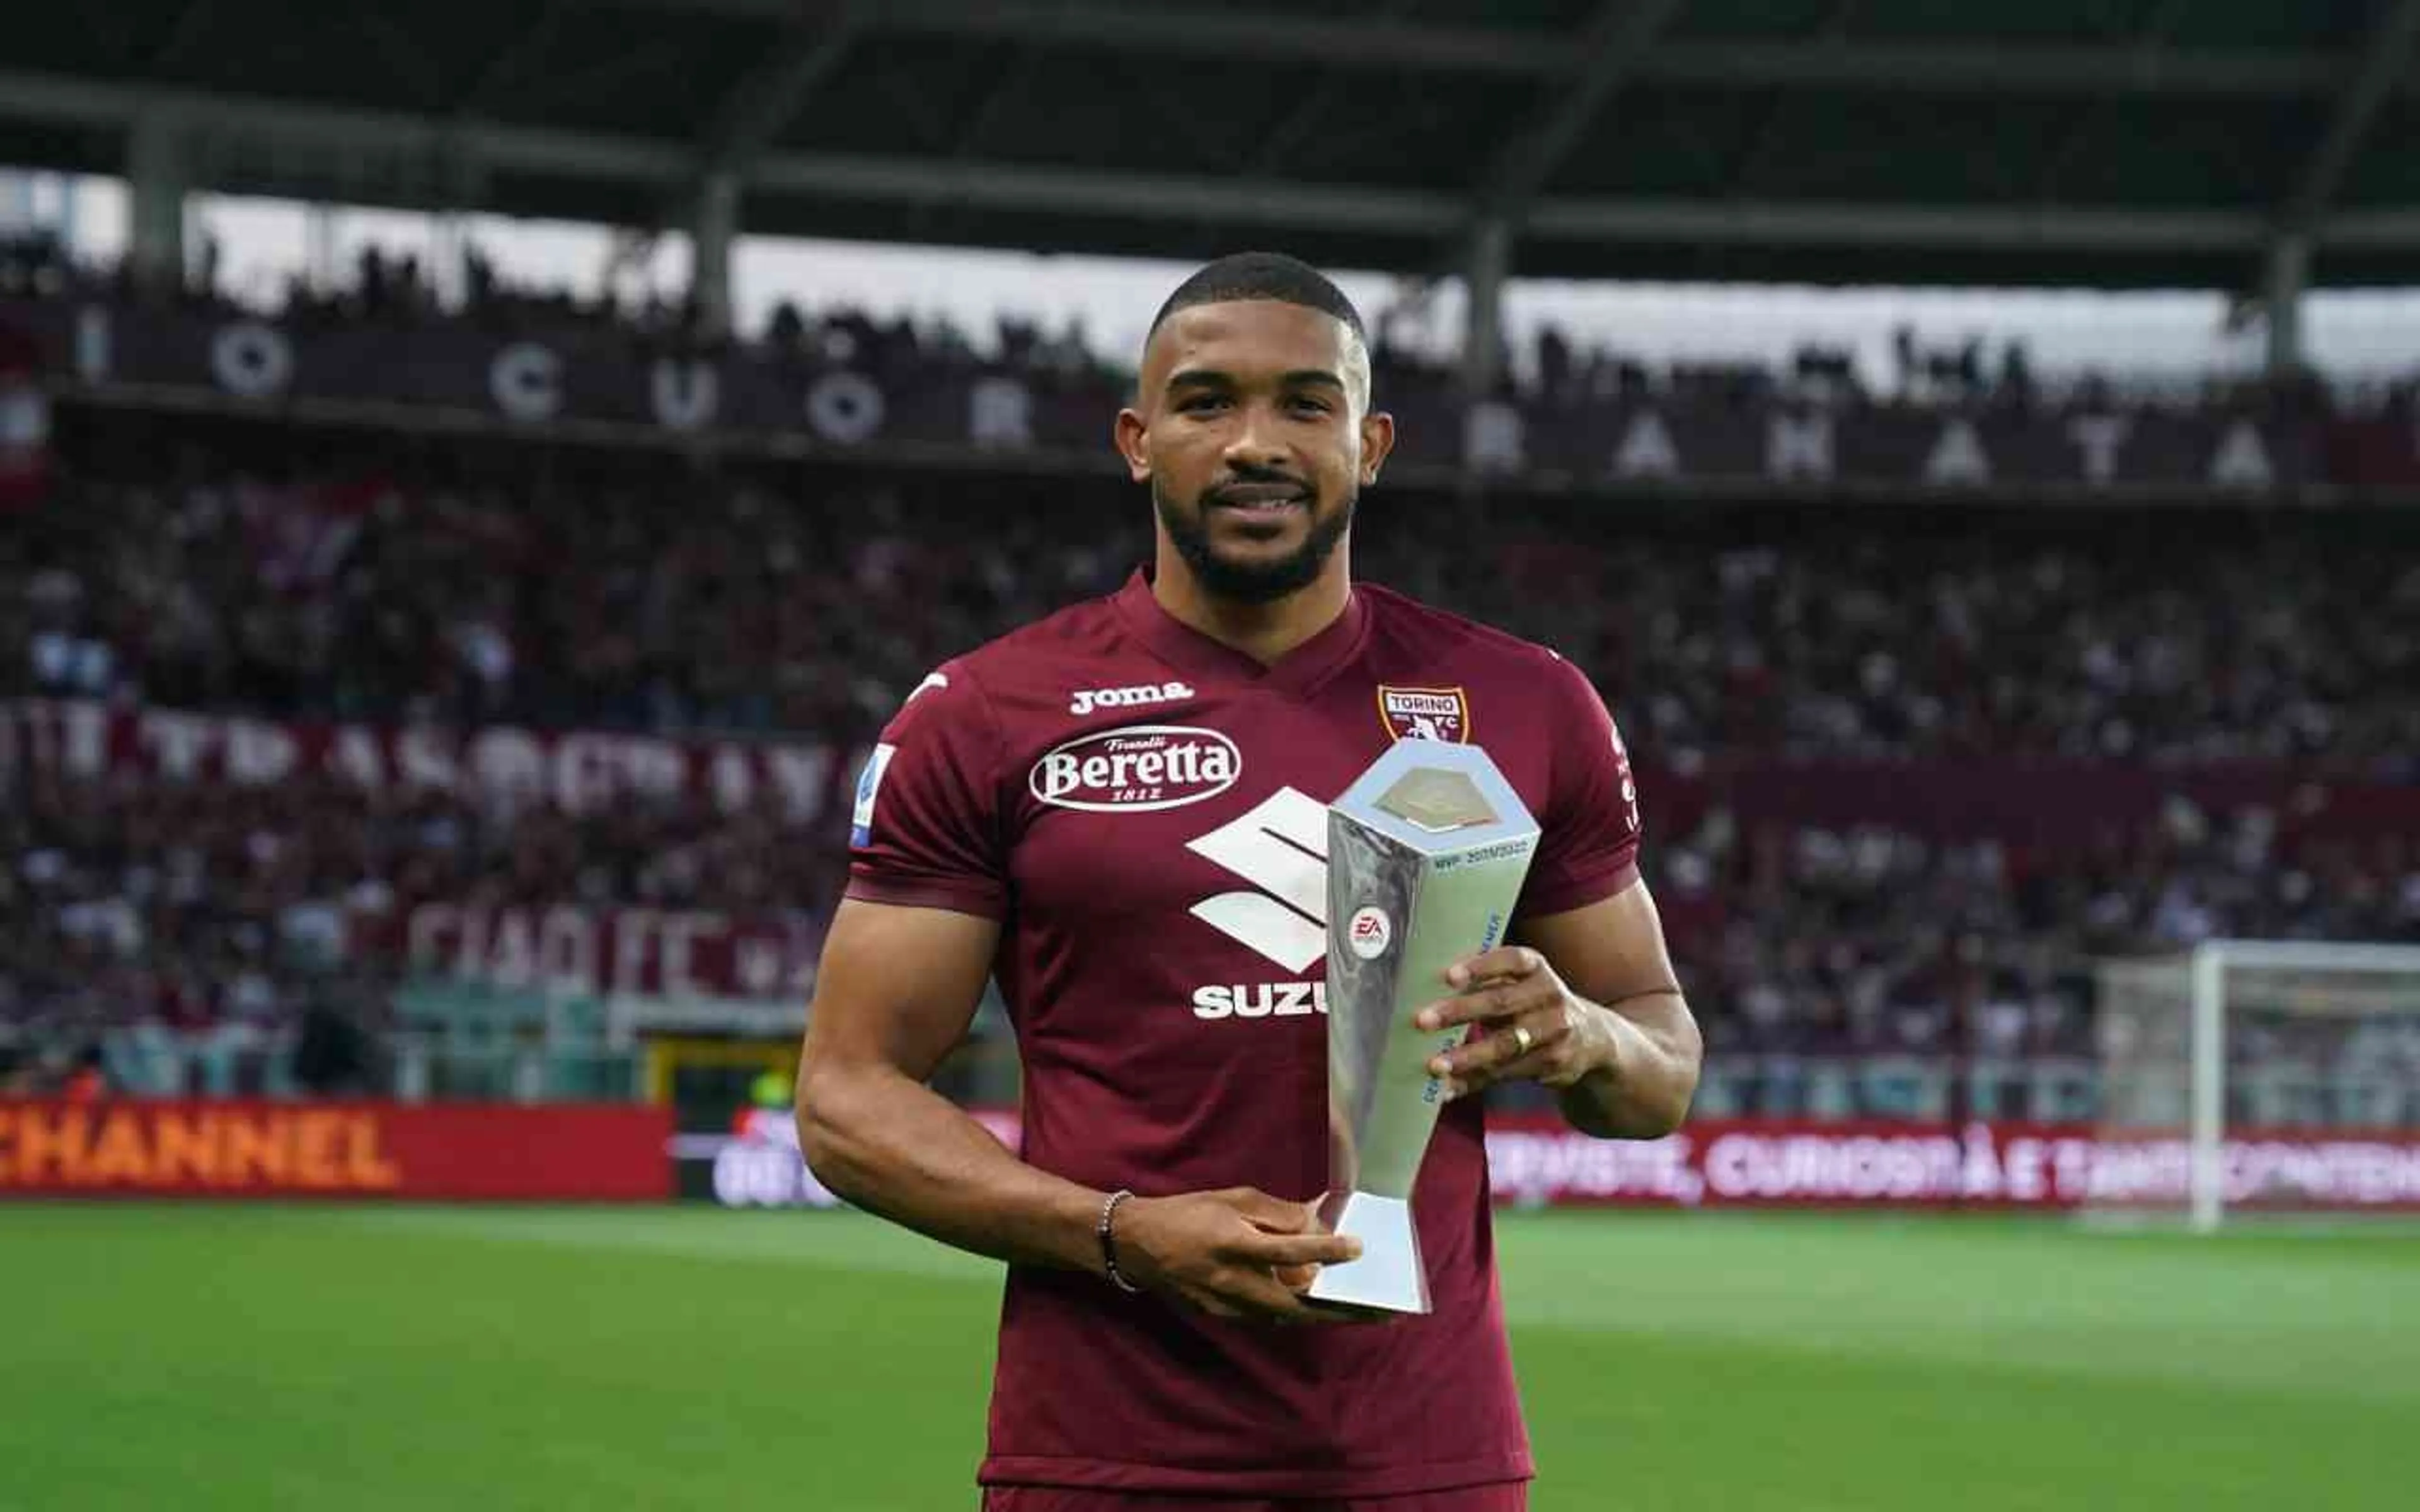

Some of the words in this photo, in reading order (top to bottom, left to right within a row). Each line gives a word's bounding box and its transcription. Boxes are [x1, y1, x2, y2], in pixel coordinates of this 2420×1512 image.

[1391, 695, 1453, 711] TORINO
[1044, 742, 1231, 798] Beretta
[1356, 916, 1383, 935] EA
[0, 1105, 398, 1186] HANNEL
